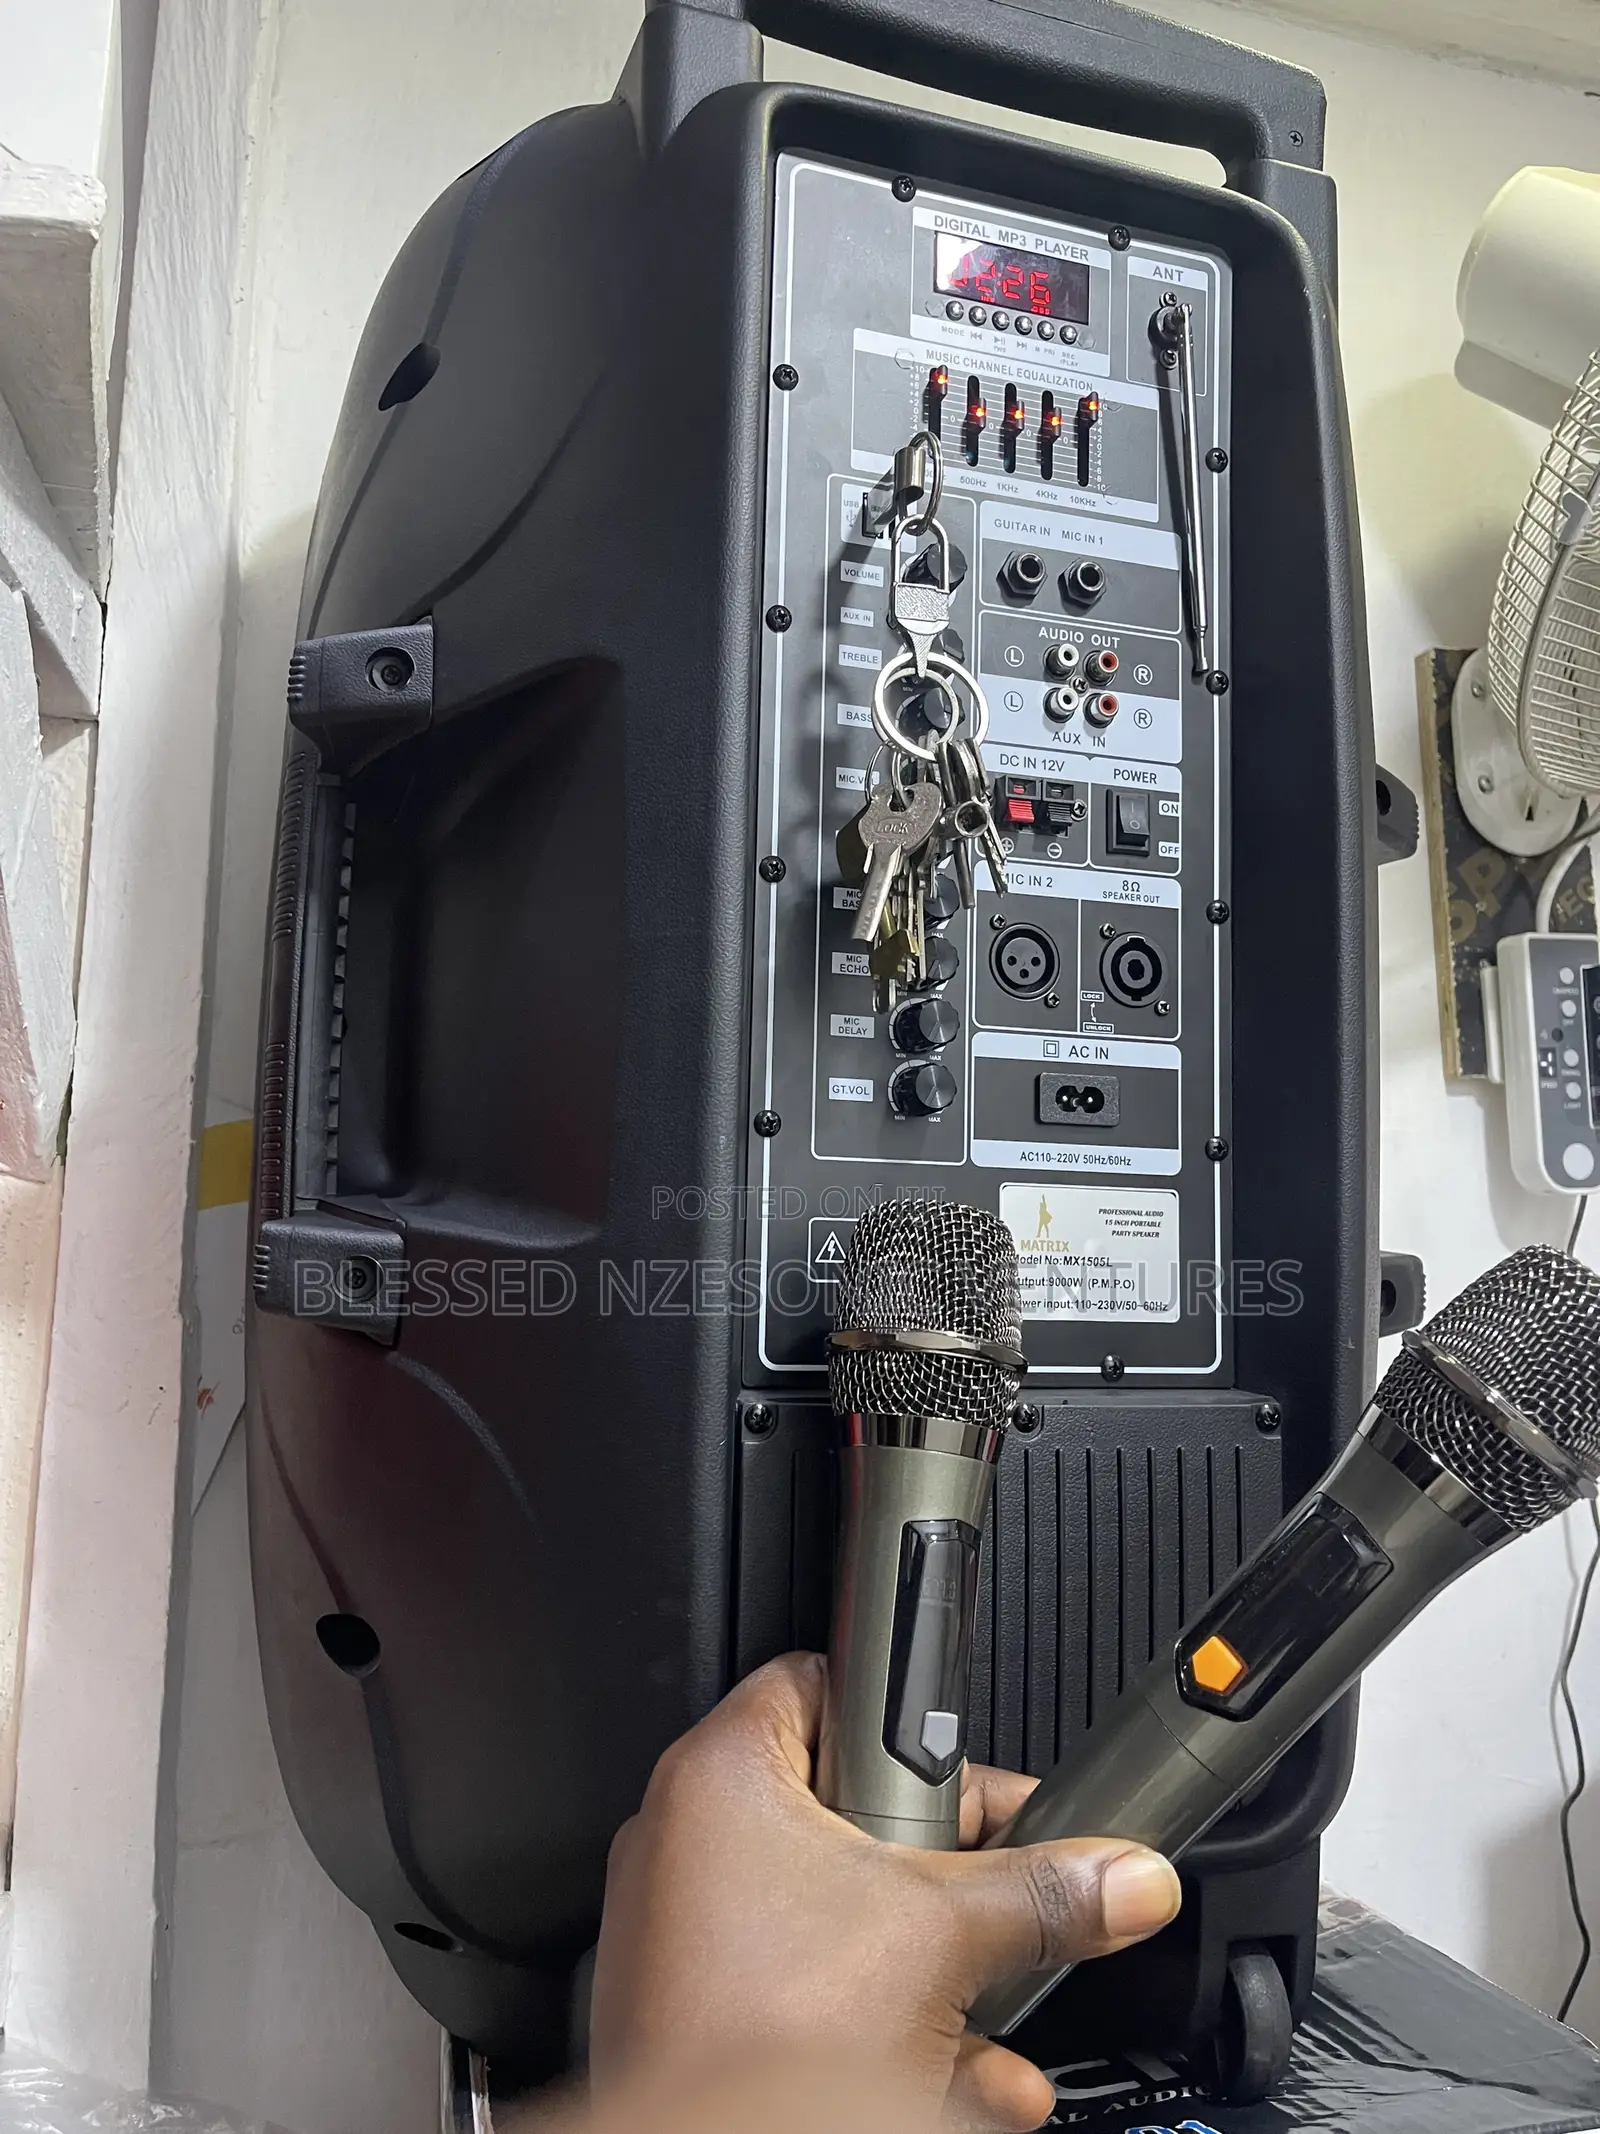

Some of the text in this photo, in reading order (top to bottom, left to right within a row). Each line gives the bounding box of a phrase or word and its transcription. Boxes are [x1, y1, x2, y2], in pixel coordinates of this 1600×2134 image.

[934, 215, 1089, 261] DIGITAL MP3 PLAYER
[1153, 265, 1184, 283] ANT
[941, 325, 965, 337] MODE
[1061, 352, 1075, 360] REC
[926, 349, 1093, 391] MUSIC CHANNEL EQUALIZATION
[960, 475, 987, 488] 500Hz
[997, 482, 1019, 494] 1KHz
[1035, 489, 1058, 500] 4KHz
[843, 499, 860, 509] USB
[1070, 495, 1097, 507] 10KHz
[994, 518, 1051, 536] GUITAR IN
[1062, 529, 1103, 545] MIC IN 1
[844, 568, 880, 581] VOLUME
[843, 612, 860, 621] AUX
[1039, 626, 1120, 649] AUDIO OUT
[842, 651, 879, 664] TREBLE
[1052, 731, 1106, 748] AUX IN
[1000, 754, 1065, 772] DC IN 12V
[839, 774, 869, 785] MIC.V
[1113, 768, 1158, 785] POWER
[1161, 803, 1179, 814] ON
[1160, 845, 1179, 855] OFF
[1029, 875, 1042, 886] IN
[1046, 876, 1053, 888] 2
[1122, 880, 1141, 893] 8Ω
[846, 890, 862, 899] MIC
[1103, 890, 1160, 904] SPEAKER OUT
[842, 899, 861, 910] BAS
[846, 954, 862, 963] MIC
[839, 963, 870, 975] ECHO
[843, 1017, 860, 1026] MIC
[838, 1026, 868, 1036] DELAY
[1068, 1045, 1109, 1060] AC IN
[832, 1085, 870, 1096] GT.VOL
[1020, 1151, 1132, 1167] AC110~220V 50Hz/60Hz
[1098, 1208, 1164, 1218] PROFESSIONAL AUDIO
[1114, 1219, 1130, 1227] INCH
[1130, 1220, 1161, 1228] PORTABLE
[1111, 1229, 1160, 1238] PARTY SPEAKER
[1020, 1239, 1070, 1252] MATRIX
[1045, 1255, 1113, 1267] No:MX1505L
[1018, 1276, 1135, 1291] utput:9000W (P.M.P.O)
